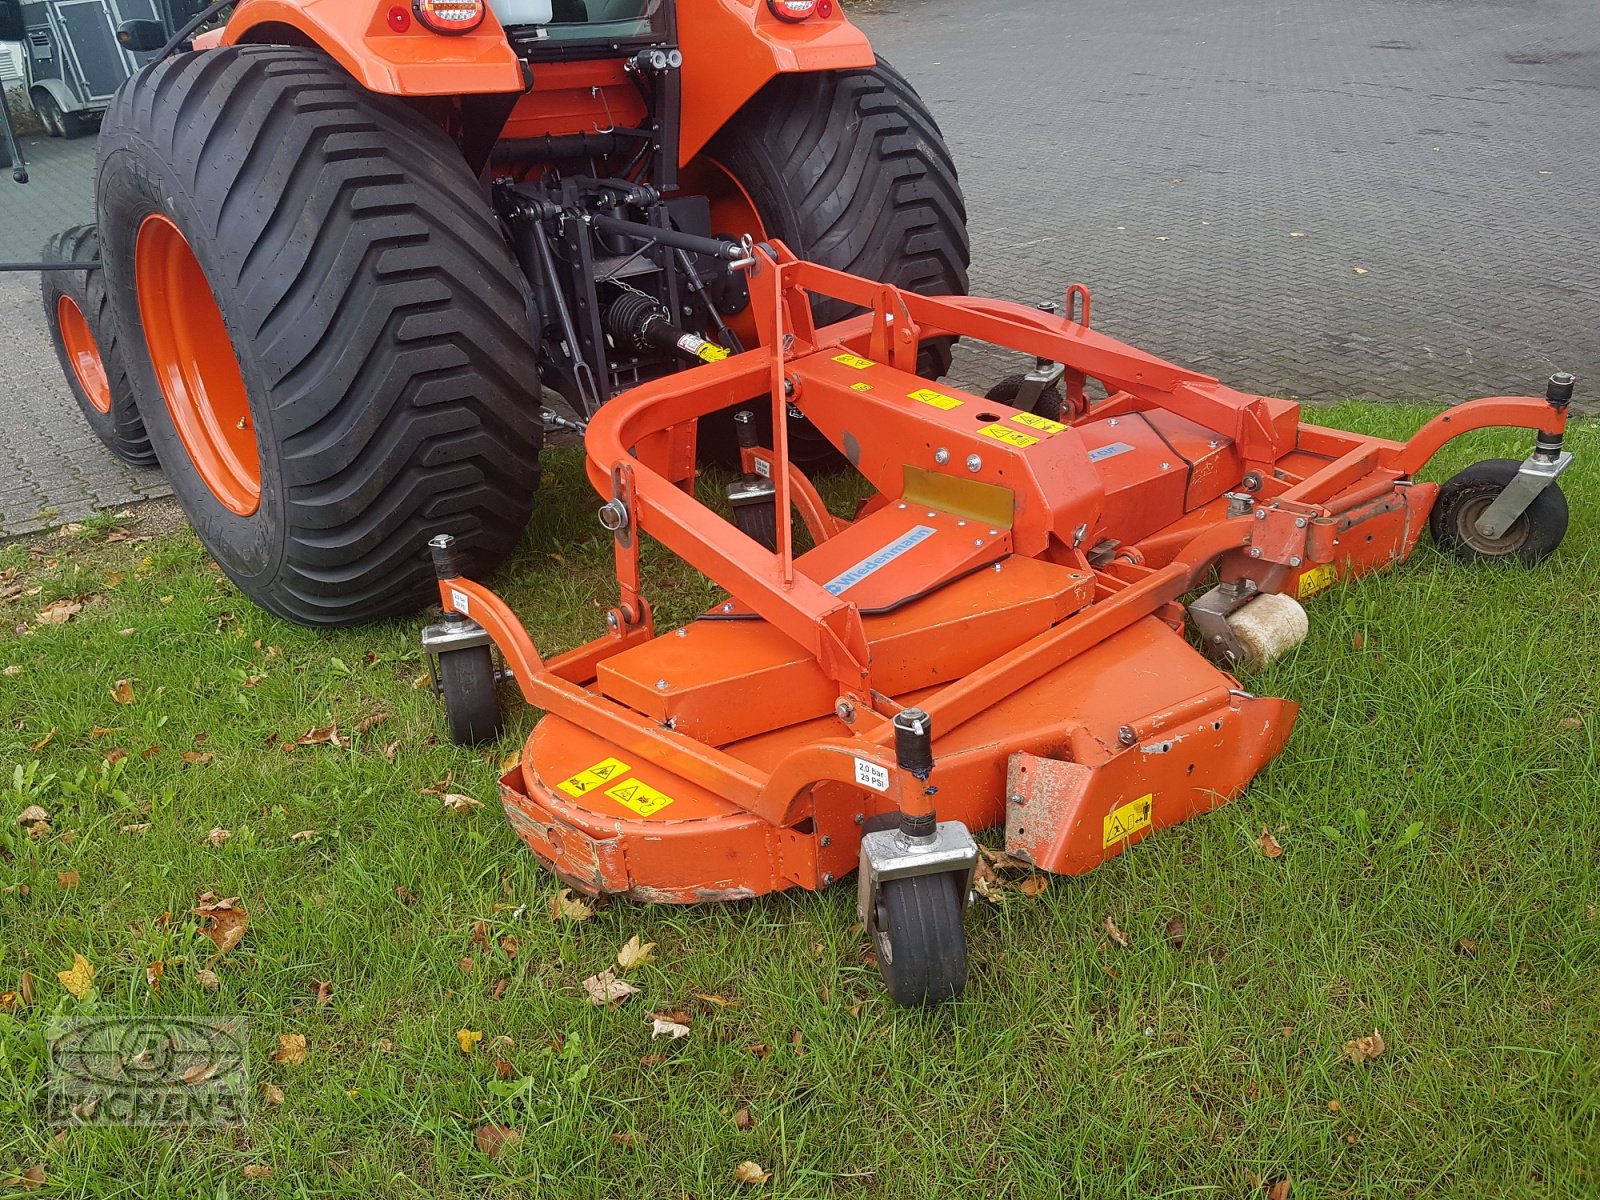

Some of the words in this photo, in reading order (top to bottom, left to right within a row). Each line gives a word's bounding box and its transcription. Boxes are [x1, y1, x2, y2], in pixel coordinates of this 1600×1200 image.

[1097, 446, 1117, 456] CUT
[835, 528, 930, 586] Wiedenmann
[871, 767, 884, 778] bar
[861, 773, 870, 782] 29
[872, 777, 884, 788] PSI
